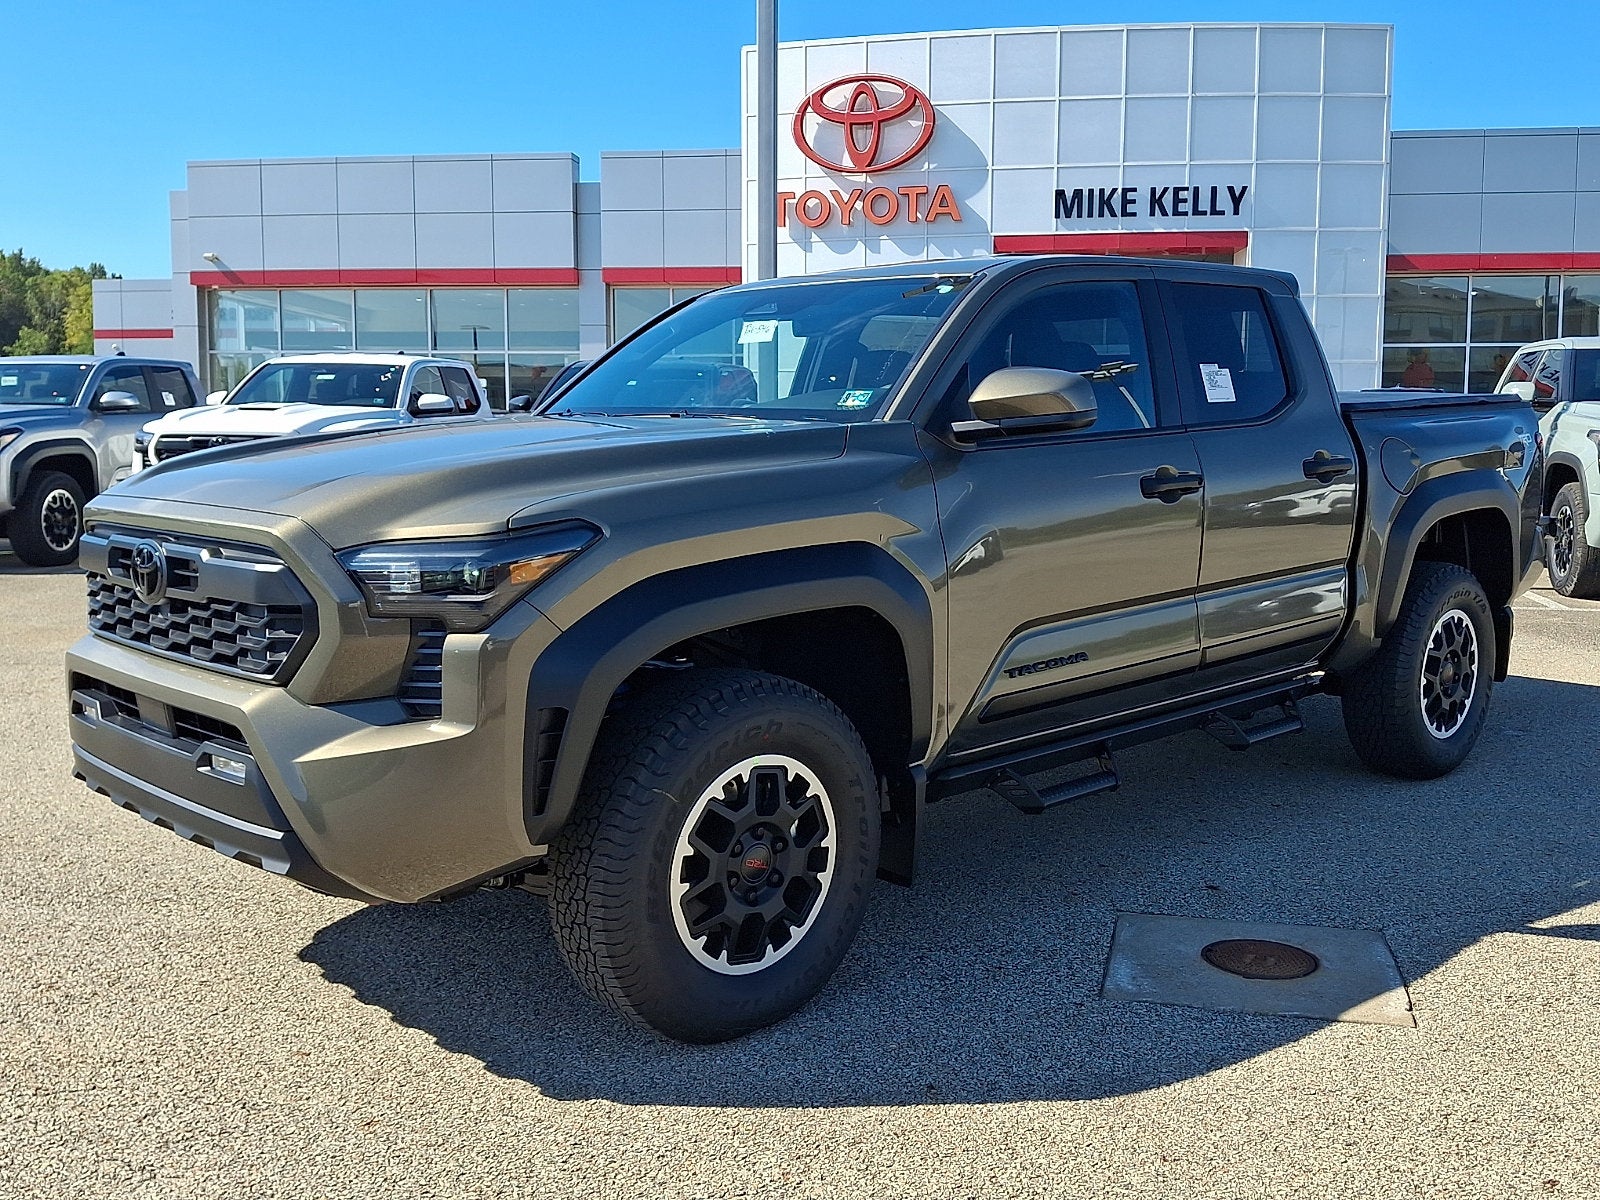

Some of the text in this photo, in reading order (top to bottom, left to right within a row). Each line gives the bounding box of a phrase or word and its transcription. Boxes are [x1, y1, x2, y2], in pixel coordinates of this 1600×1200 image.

[777, 184, 962, 228] TOYOTA
[1054, 185, 1249, 219] MIKE KELLY
[1003, 651, 1089, 678] TACOMA
[745, 858, 768, 870] TRD
